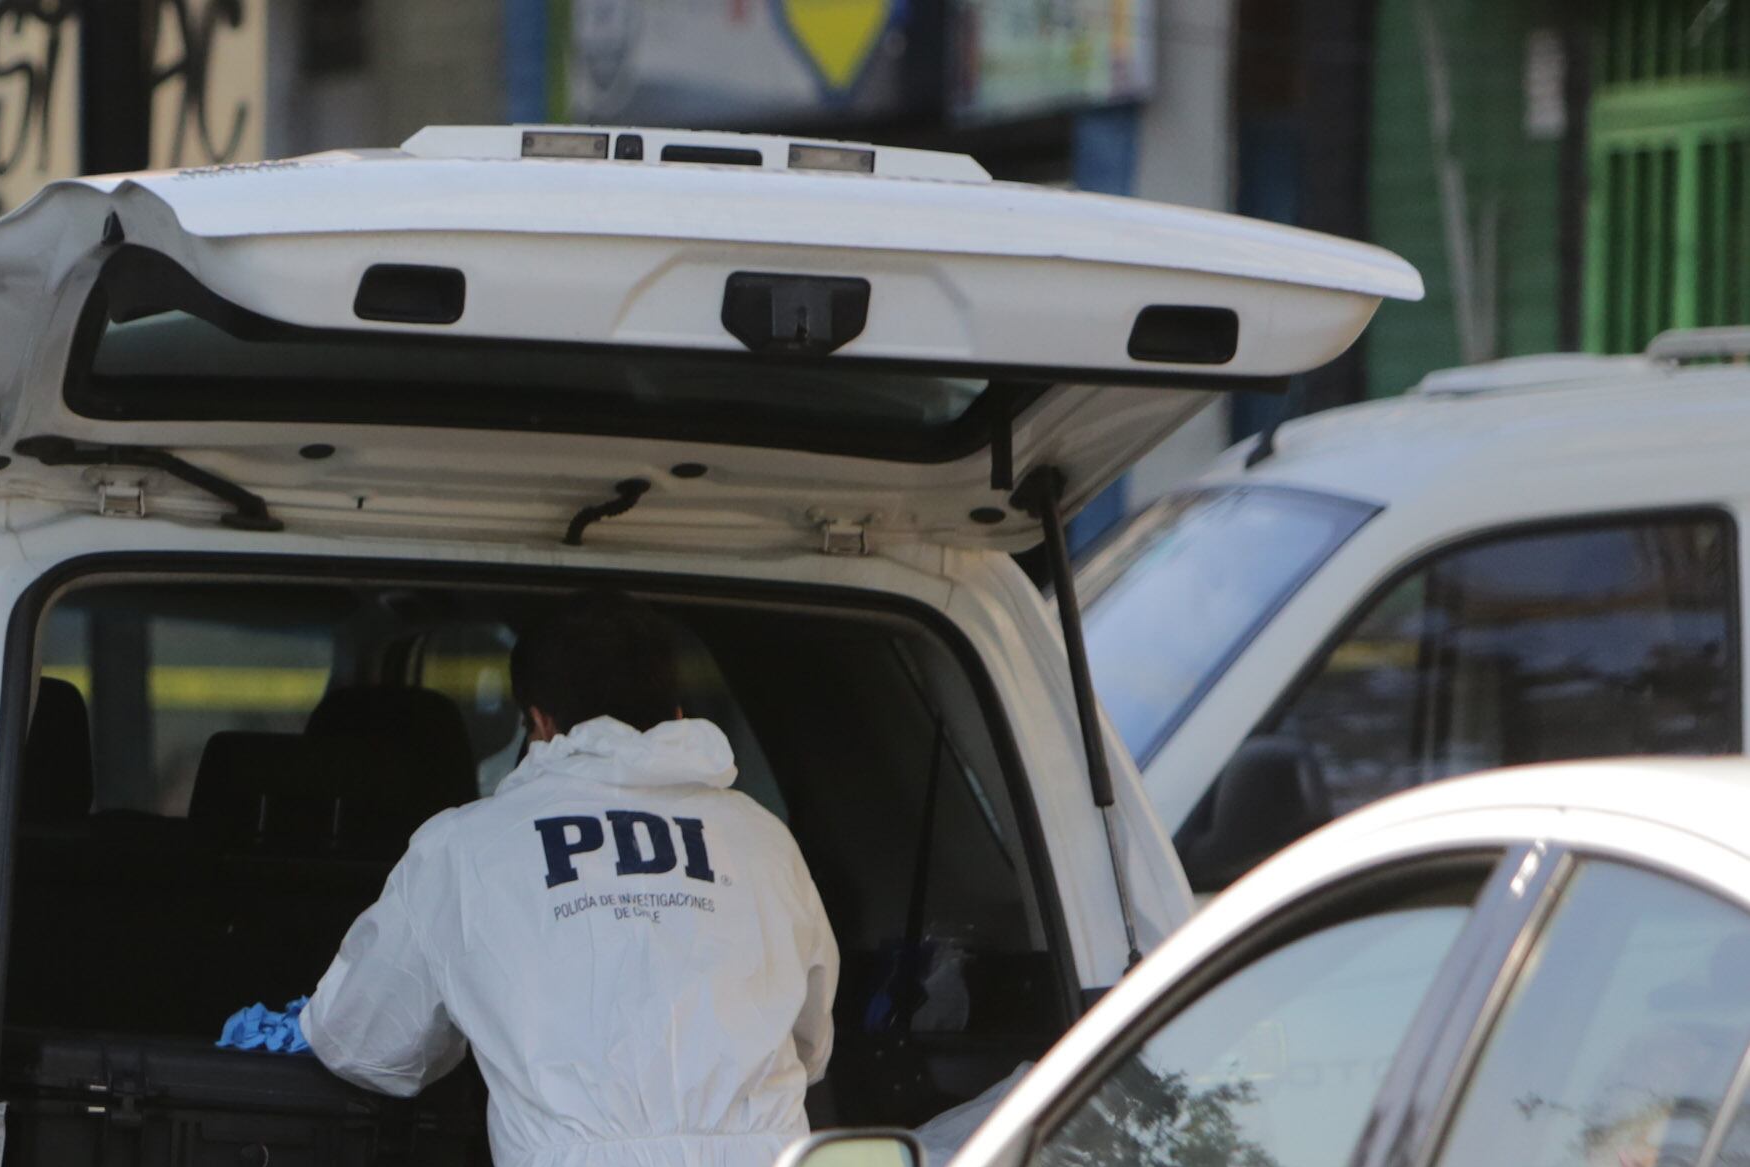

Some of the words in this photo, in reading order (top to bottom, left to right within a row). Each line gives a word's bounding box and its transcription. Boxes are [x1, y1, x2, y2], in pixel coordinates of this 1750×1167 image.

[534, 810, 715, 889] PDI
[554, 894, 598, 921] POLICÍA
[600, 894, 615, 906] DE
[614, 907, 631, 921] DE
